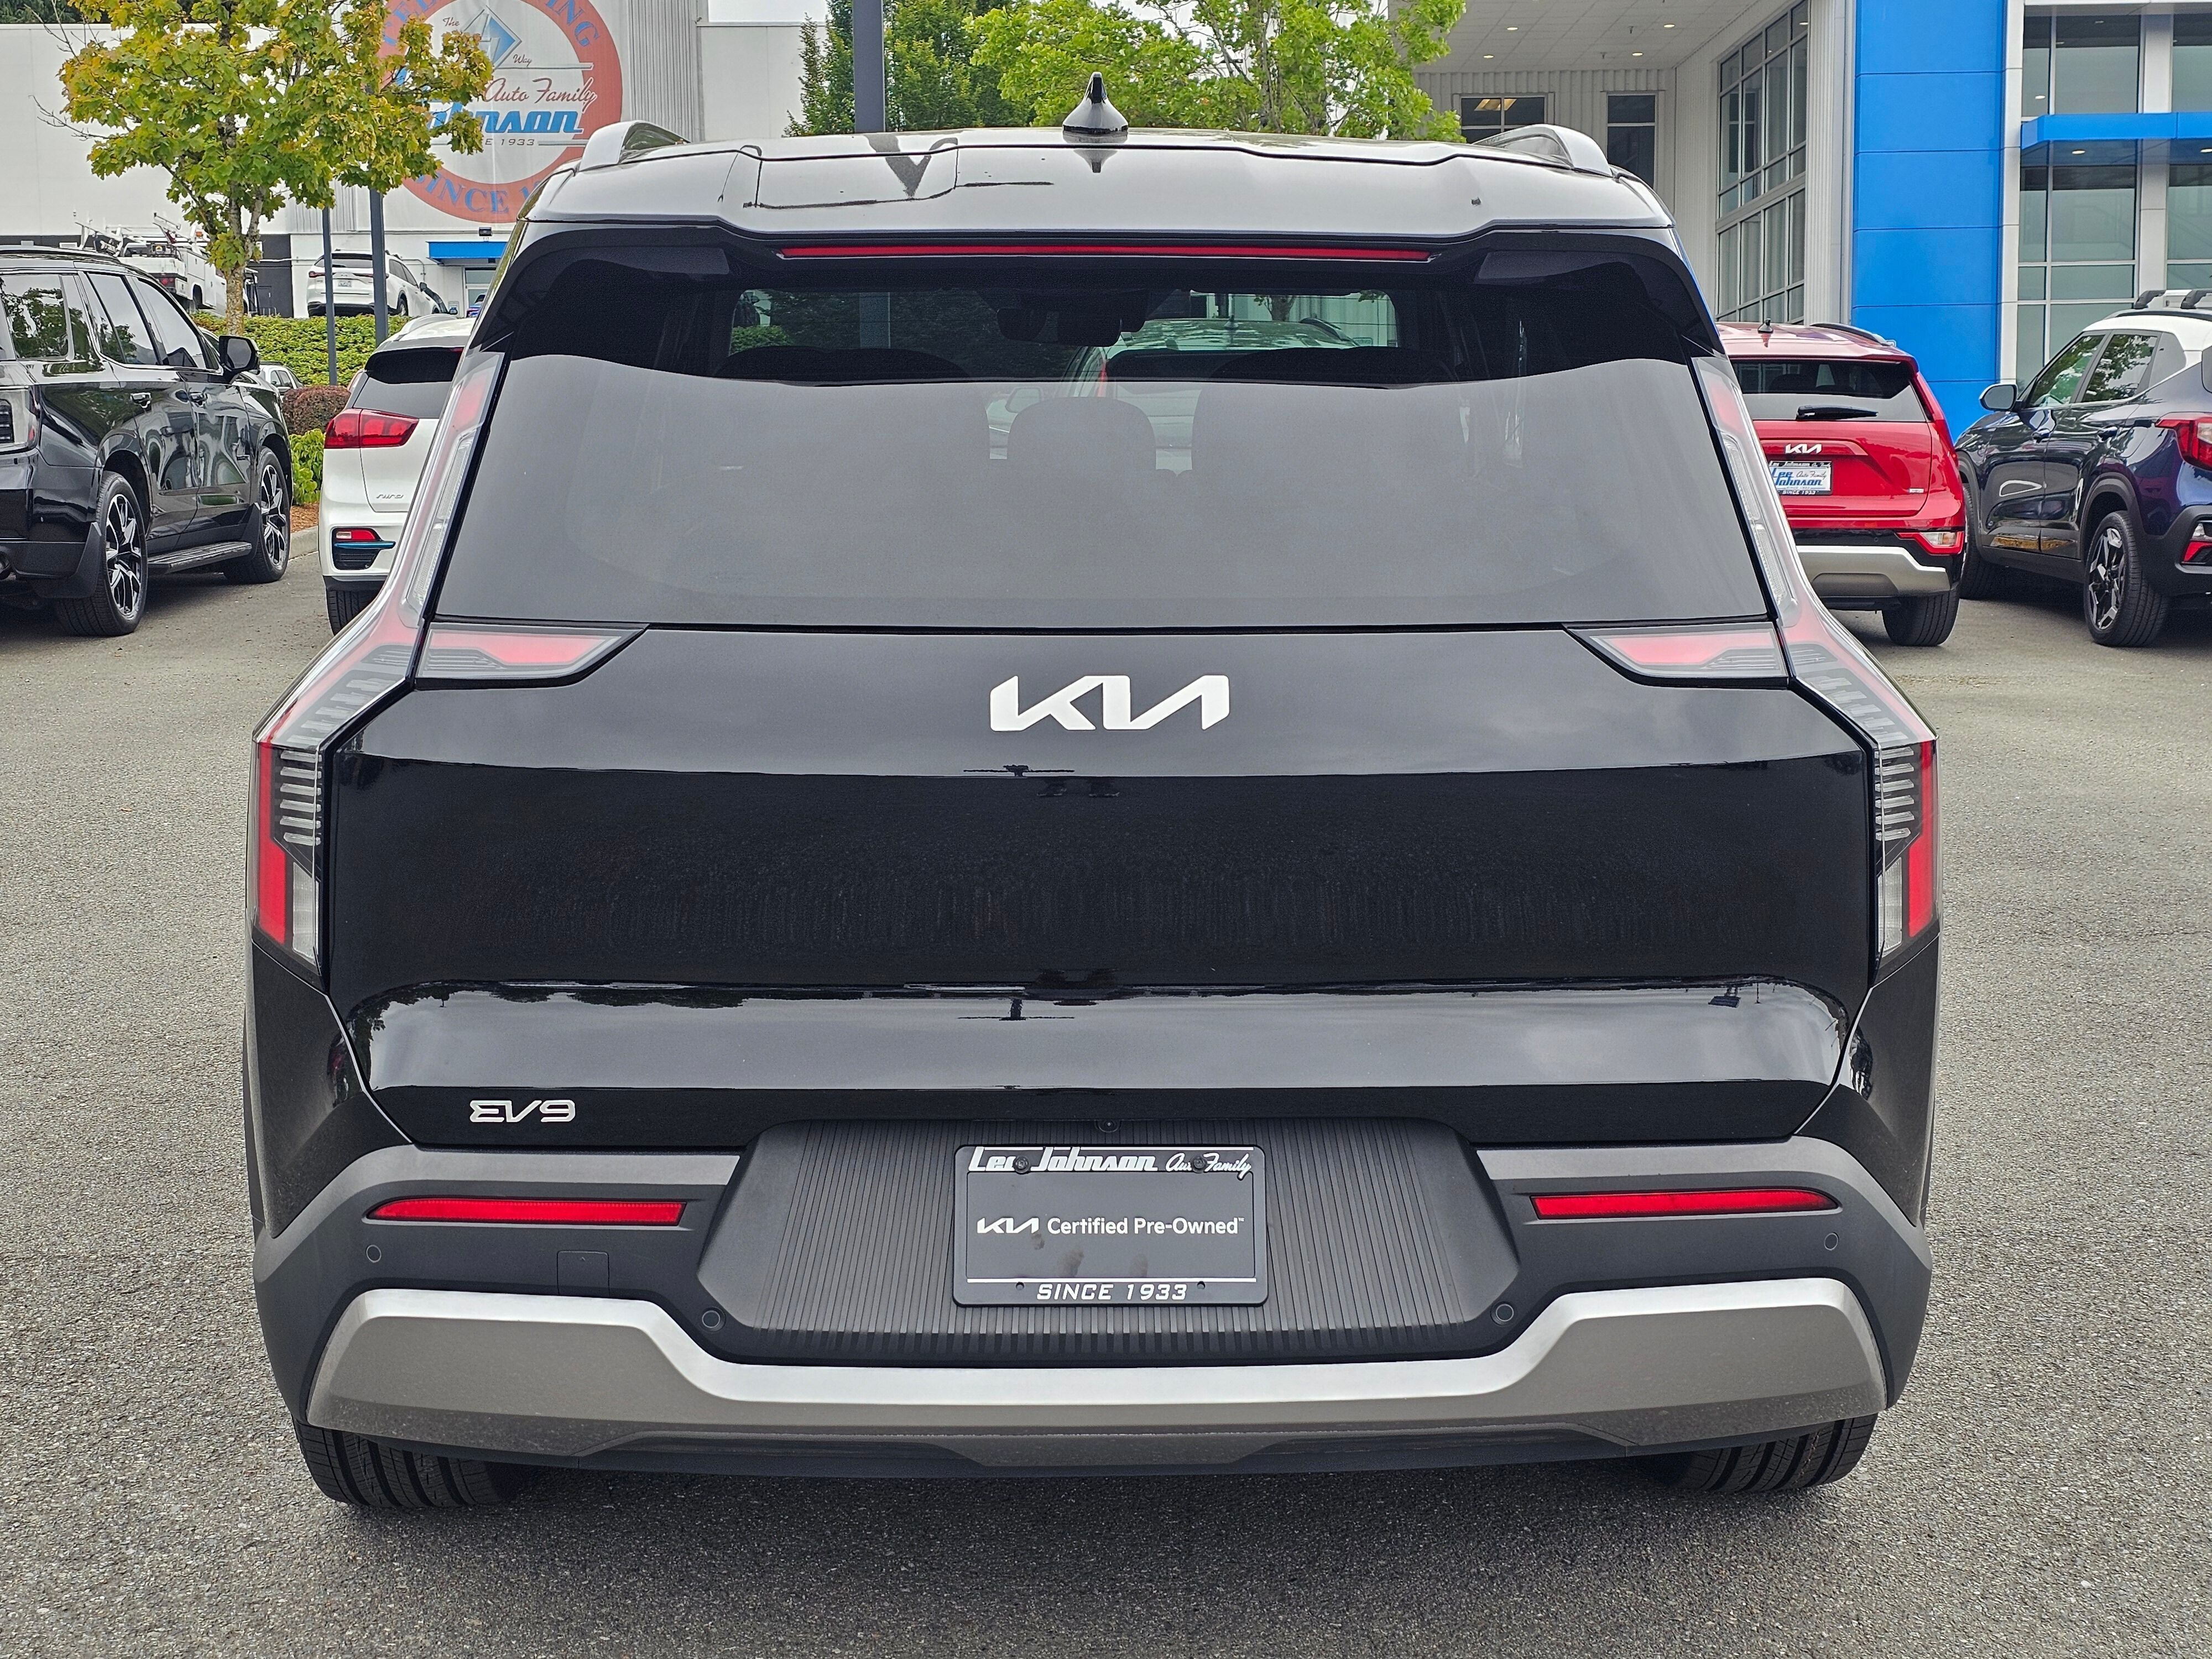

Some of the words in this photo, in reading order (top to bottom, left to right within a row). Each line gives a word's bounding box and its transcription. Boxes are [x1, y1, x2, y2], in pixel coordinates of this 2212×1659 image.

[443, 17, 460, 27] The
[513, 54, 532, 67] Way
[484, 78, 530, 102] Auto
[531, 77, 598, 113] Family
[1785, 444, 1822, 454] KIA
[1775, 476, 1823, 486] Johnson
[990, 675, 1230, 732] KIA
[469, 1099, 576, 1123] EV9
[1030, 1146, 1159, 1172] Johnson
[1203, 1152, 1253, 1180] Family
[977, 1217, 1039, 1234] KIA
[1047, 1217, 1128, 1234] Certified
[1036, 1284, 1114, 1301] SINCE
[1126, 1284, 1187, 1301] 1933
